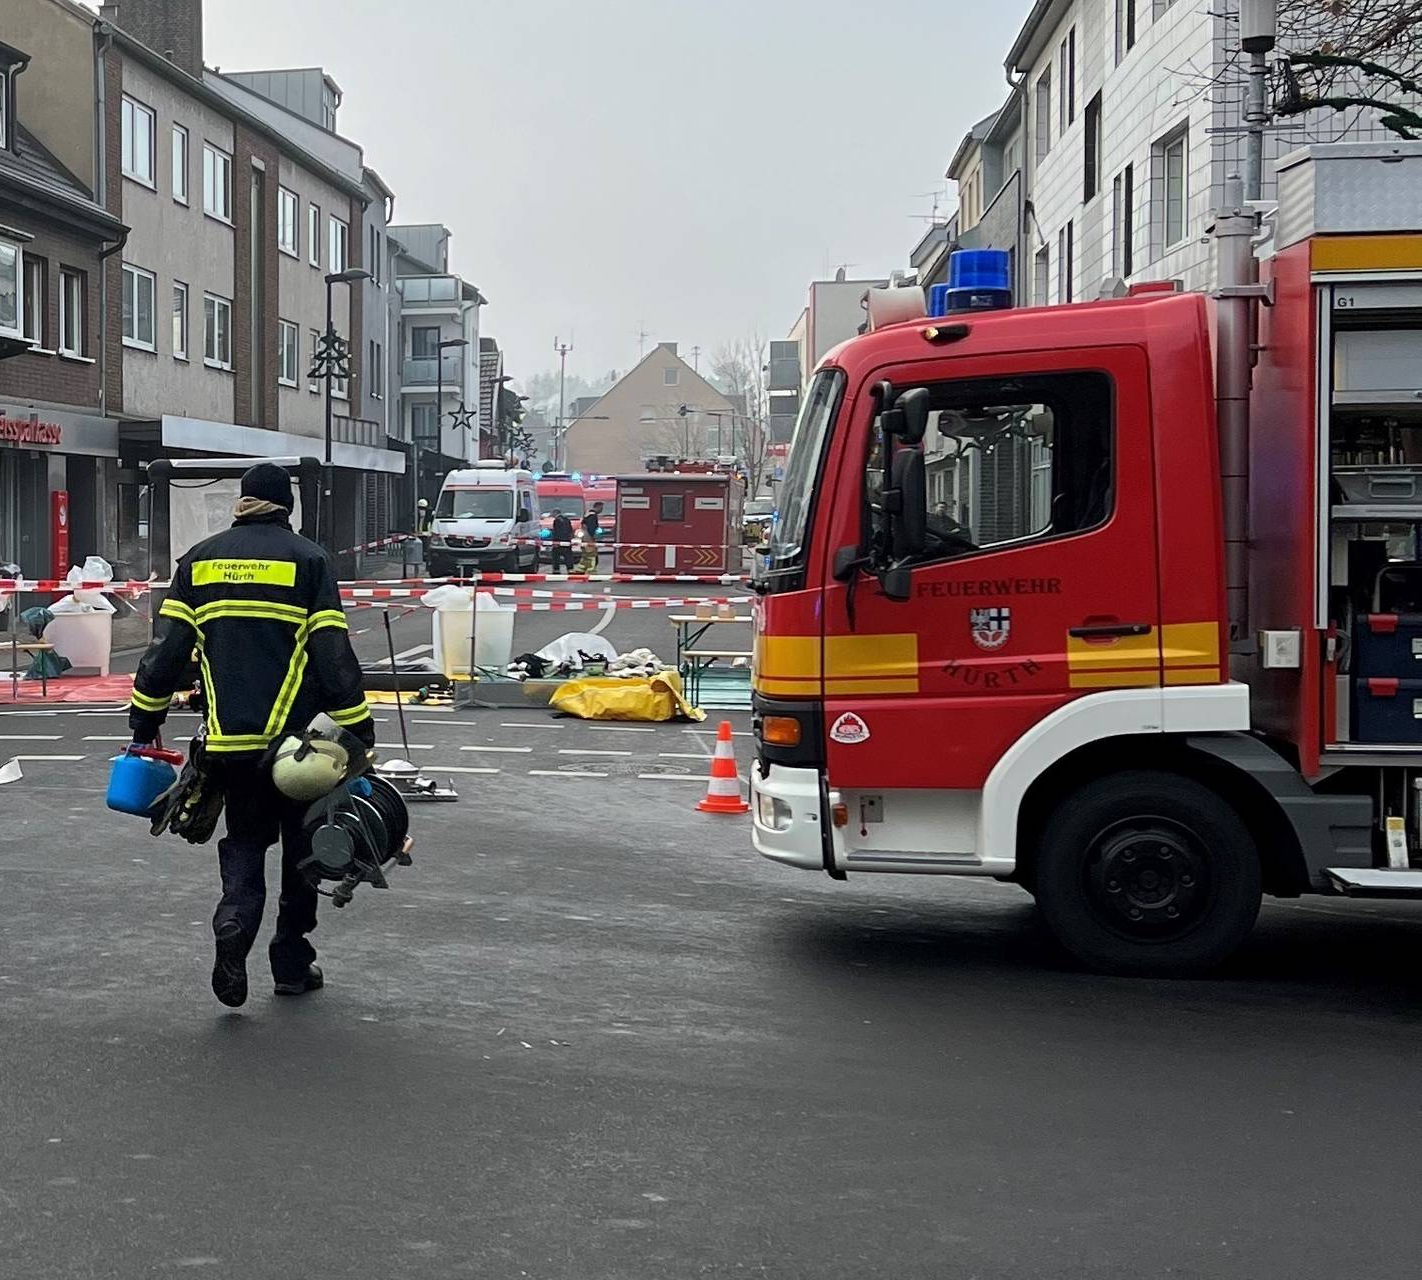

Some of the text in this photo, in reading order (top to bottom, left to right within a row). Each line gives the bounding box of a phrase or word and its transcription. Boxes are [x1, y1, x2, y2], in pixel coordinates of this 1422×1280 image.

[1338, 297, 1354, 307] G1
[212, 561, 271, 571] Feuerwehr
[223, 571, 254, 581] Hürth
[916, 577, 1062, 598] FEUERWEHR
